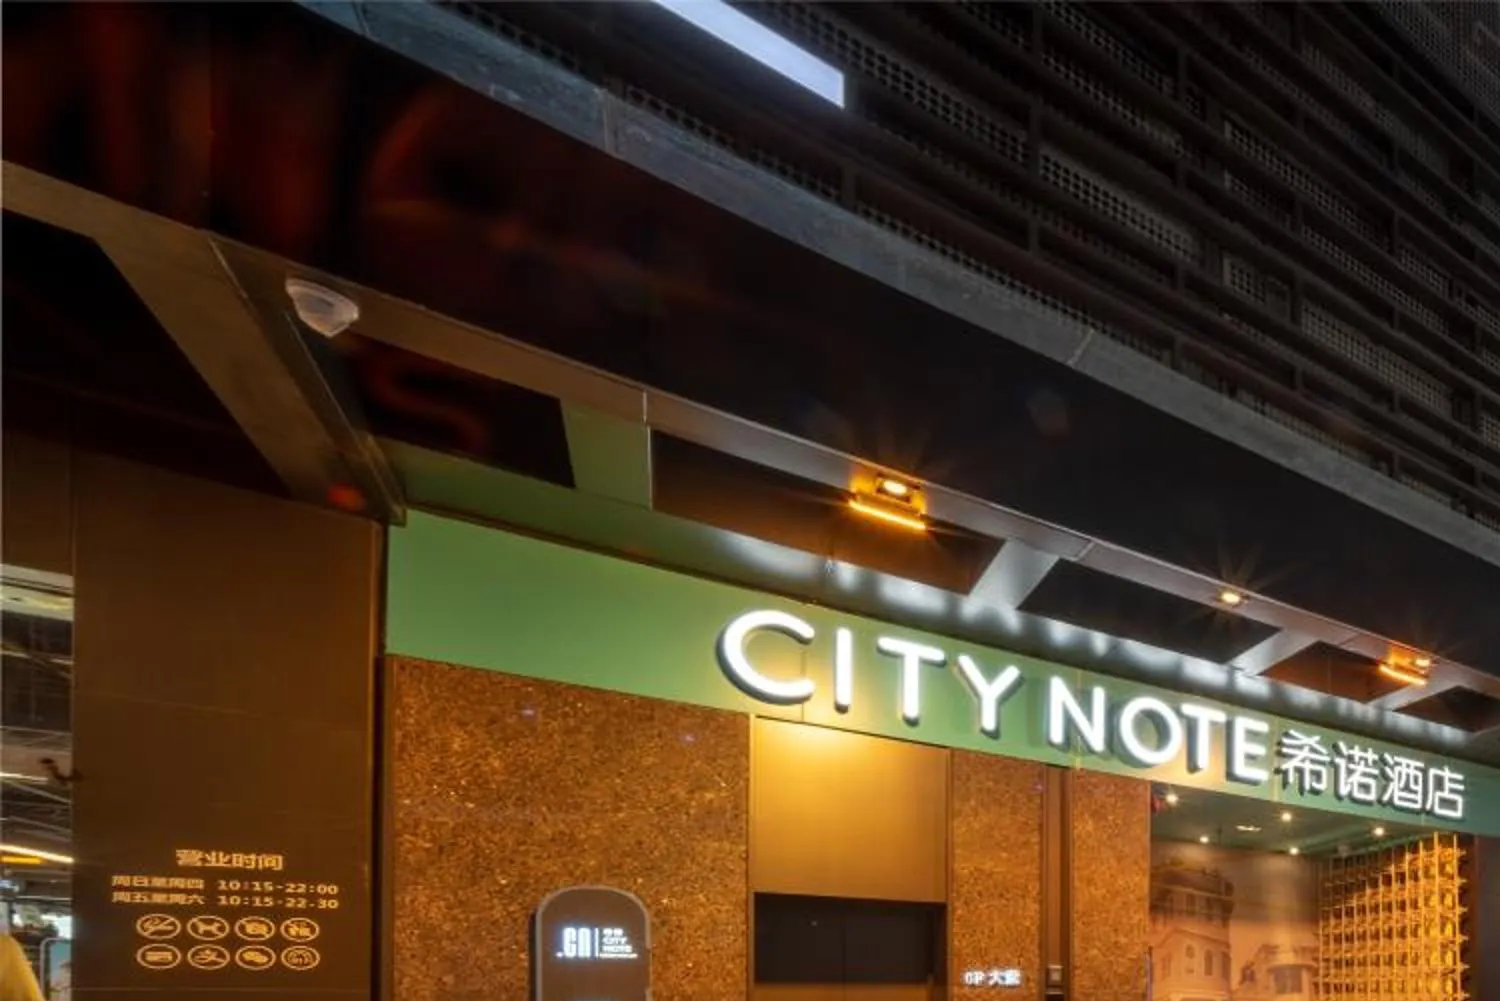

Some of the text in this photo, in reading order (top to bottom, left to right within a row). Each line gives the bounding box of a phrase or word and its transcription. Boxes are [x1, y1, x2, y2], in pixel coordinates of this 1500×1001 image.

[719, 609, 1465, 819] CITY NOTE 希诺酒店
[175, 849, 284, 871] 营业时间
[217, 879, 339, 895] 10:15-22:00
